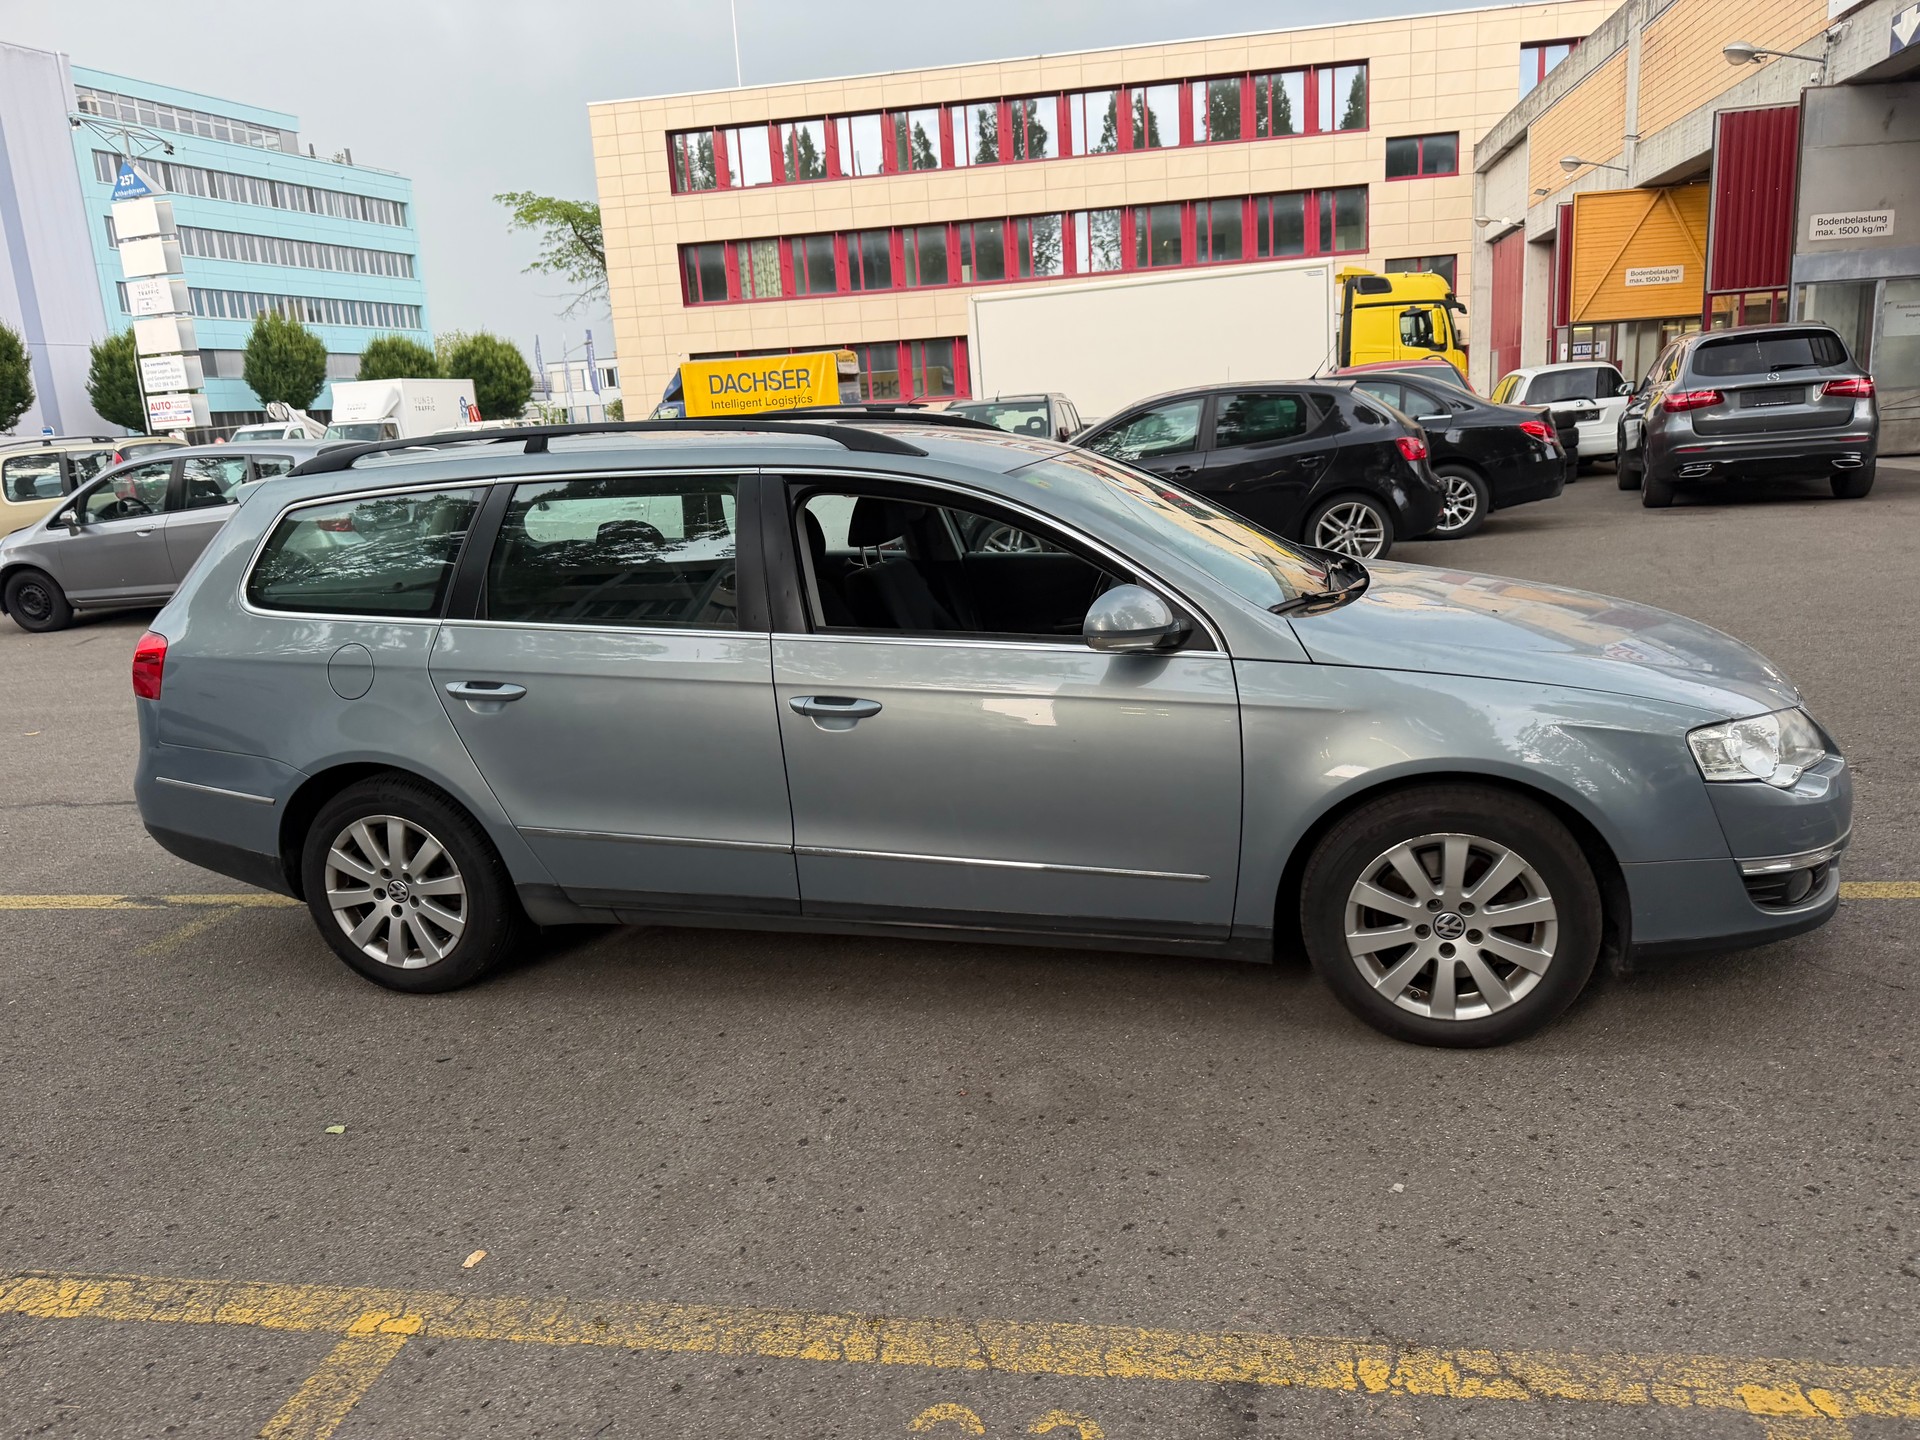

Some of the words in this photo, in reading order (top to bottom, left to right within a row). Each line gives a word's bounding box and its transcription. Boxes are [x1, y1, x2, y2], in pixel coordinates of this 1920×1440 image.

[120, 174, 135, 187] 257
[1817, 215, 1888, 226] Bodenbelastung
[1815, 228, 1836, 237] max.
[1839, 225, 1860, 235] 1500
[1630, 268, 1679, 277] Bodenbelastung
[708, 368, 811, 395] DACHSER
[150, 402, 171, 411] AUTO
[711, 398, 763, 410] Intelligent
[765, 395, 814, 408] Logistics
